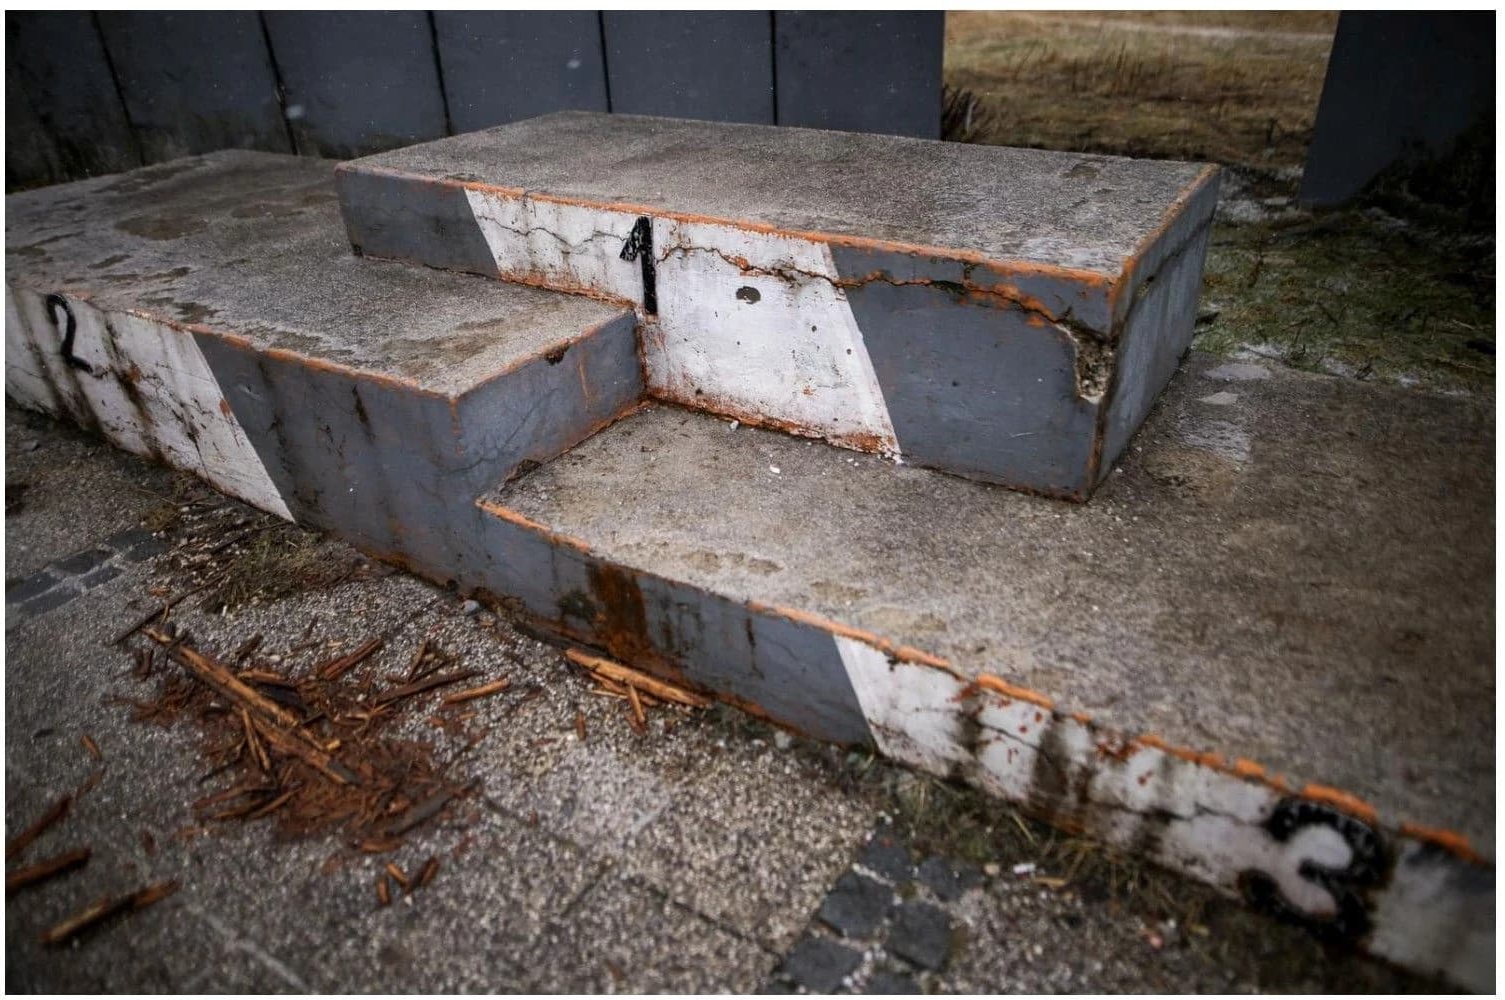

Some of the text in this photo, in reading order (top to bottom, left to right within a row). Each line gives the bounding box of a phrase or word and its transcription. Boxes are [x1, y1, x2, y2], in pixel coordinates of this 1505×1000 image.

[620, 215, 658, 315] 1
[46, 293, 94, 374] 2
[1238, 797, 1395, 955] 3
